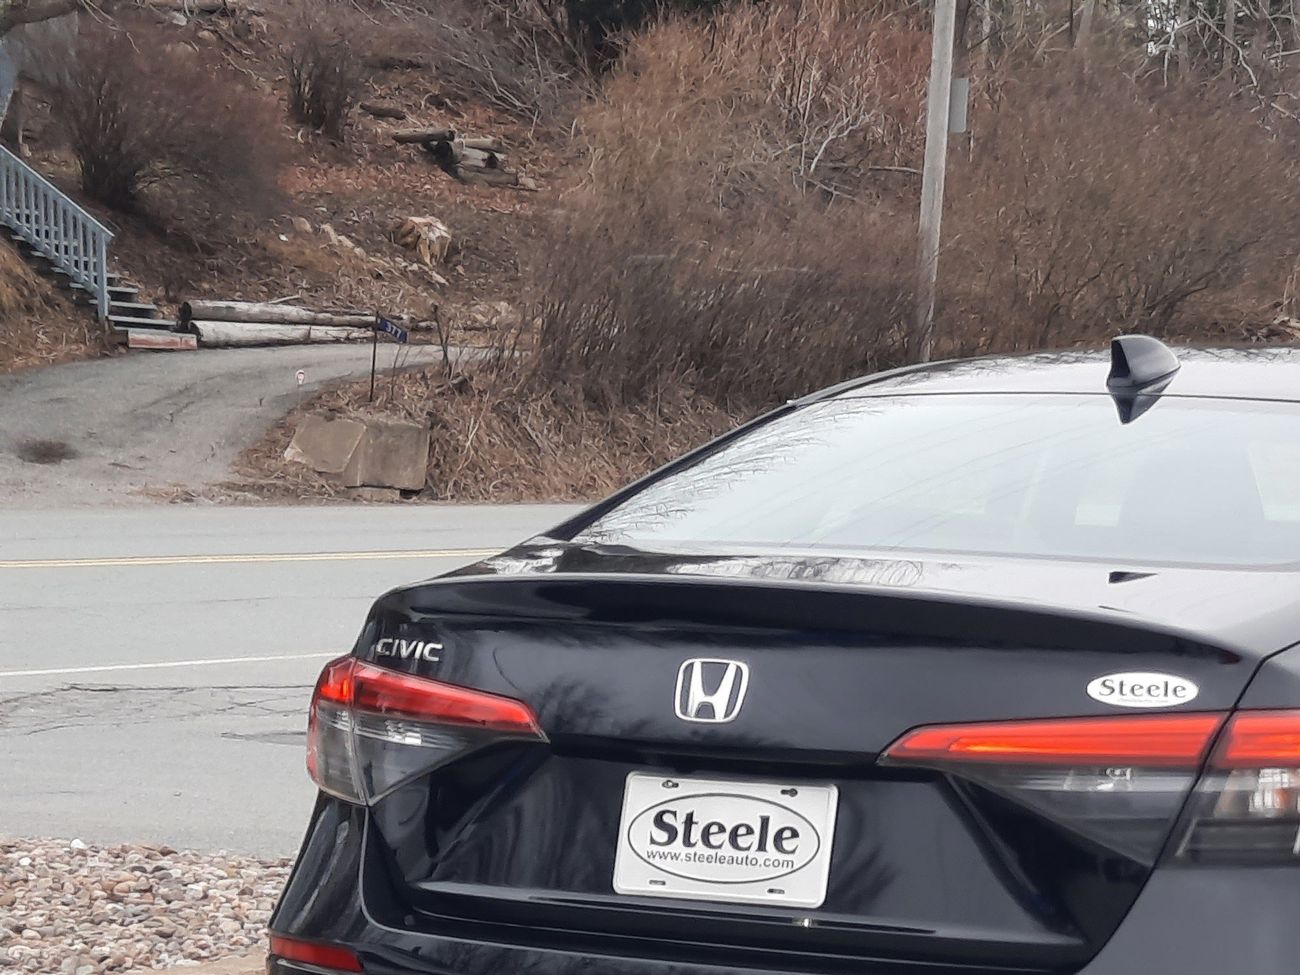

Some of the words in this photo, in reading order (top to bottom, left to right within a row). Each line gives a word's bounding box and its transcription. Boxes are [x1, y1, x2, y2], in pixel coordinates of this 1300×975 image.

[385, 321, 402, 339] 377
[376, 638, 443, 661] CIVIC
[1098, 678, 1188, 698] Steele
[649, 808, 800, 855] Steele
[646, 848, 795, 869] www.steeleauto.com
